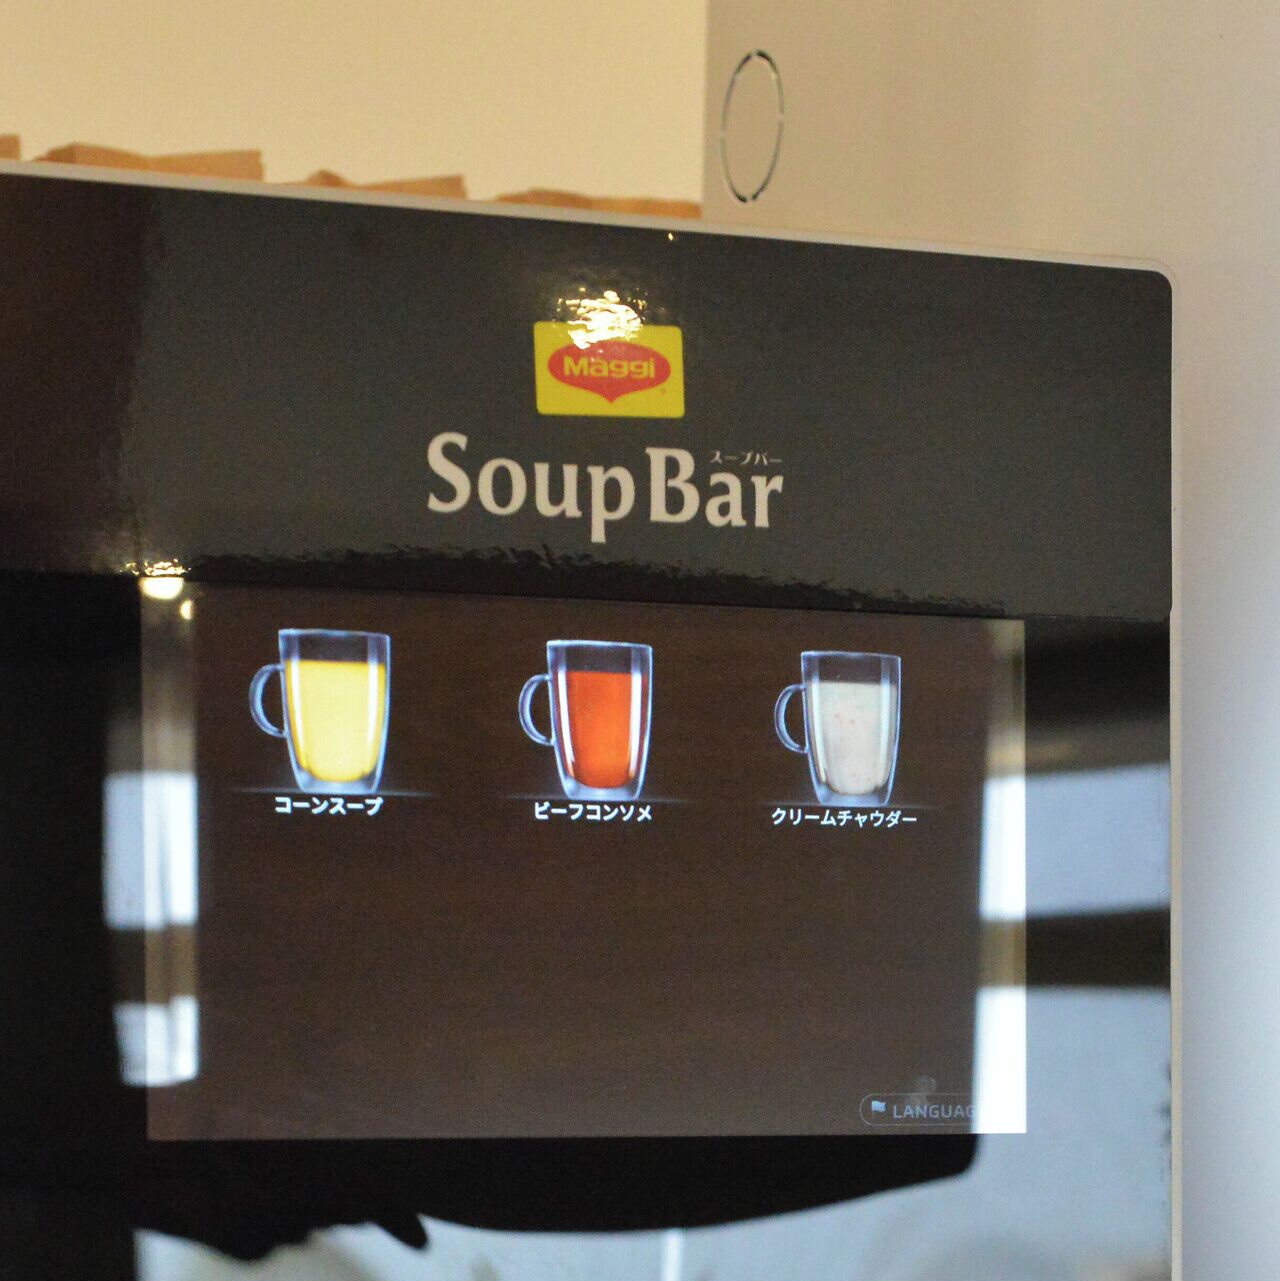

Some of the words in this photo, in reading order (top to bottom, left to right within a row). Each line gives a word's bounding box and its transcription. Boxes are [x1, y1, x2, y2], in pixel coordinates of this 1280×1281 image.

[562, 355, 655, 380] Maggi
[426, 431, 636, 543] Soup
[645, 446, 784, 528] Bar
[275, 796, 384, 816] コーンスープ
[534, 801, 652, 822] ビーフコンソメ
[771, 807, 918, 828] クリームチャウダー
[892, 1104, 976, 1119] LANGUAG
